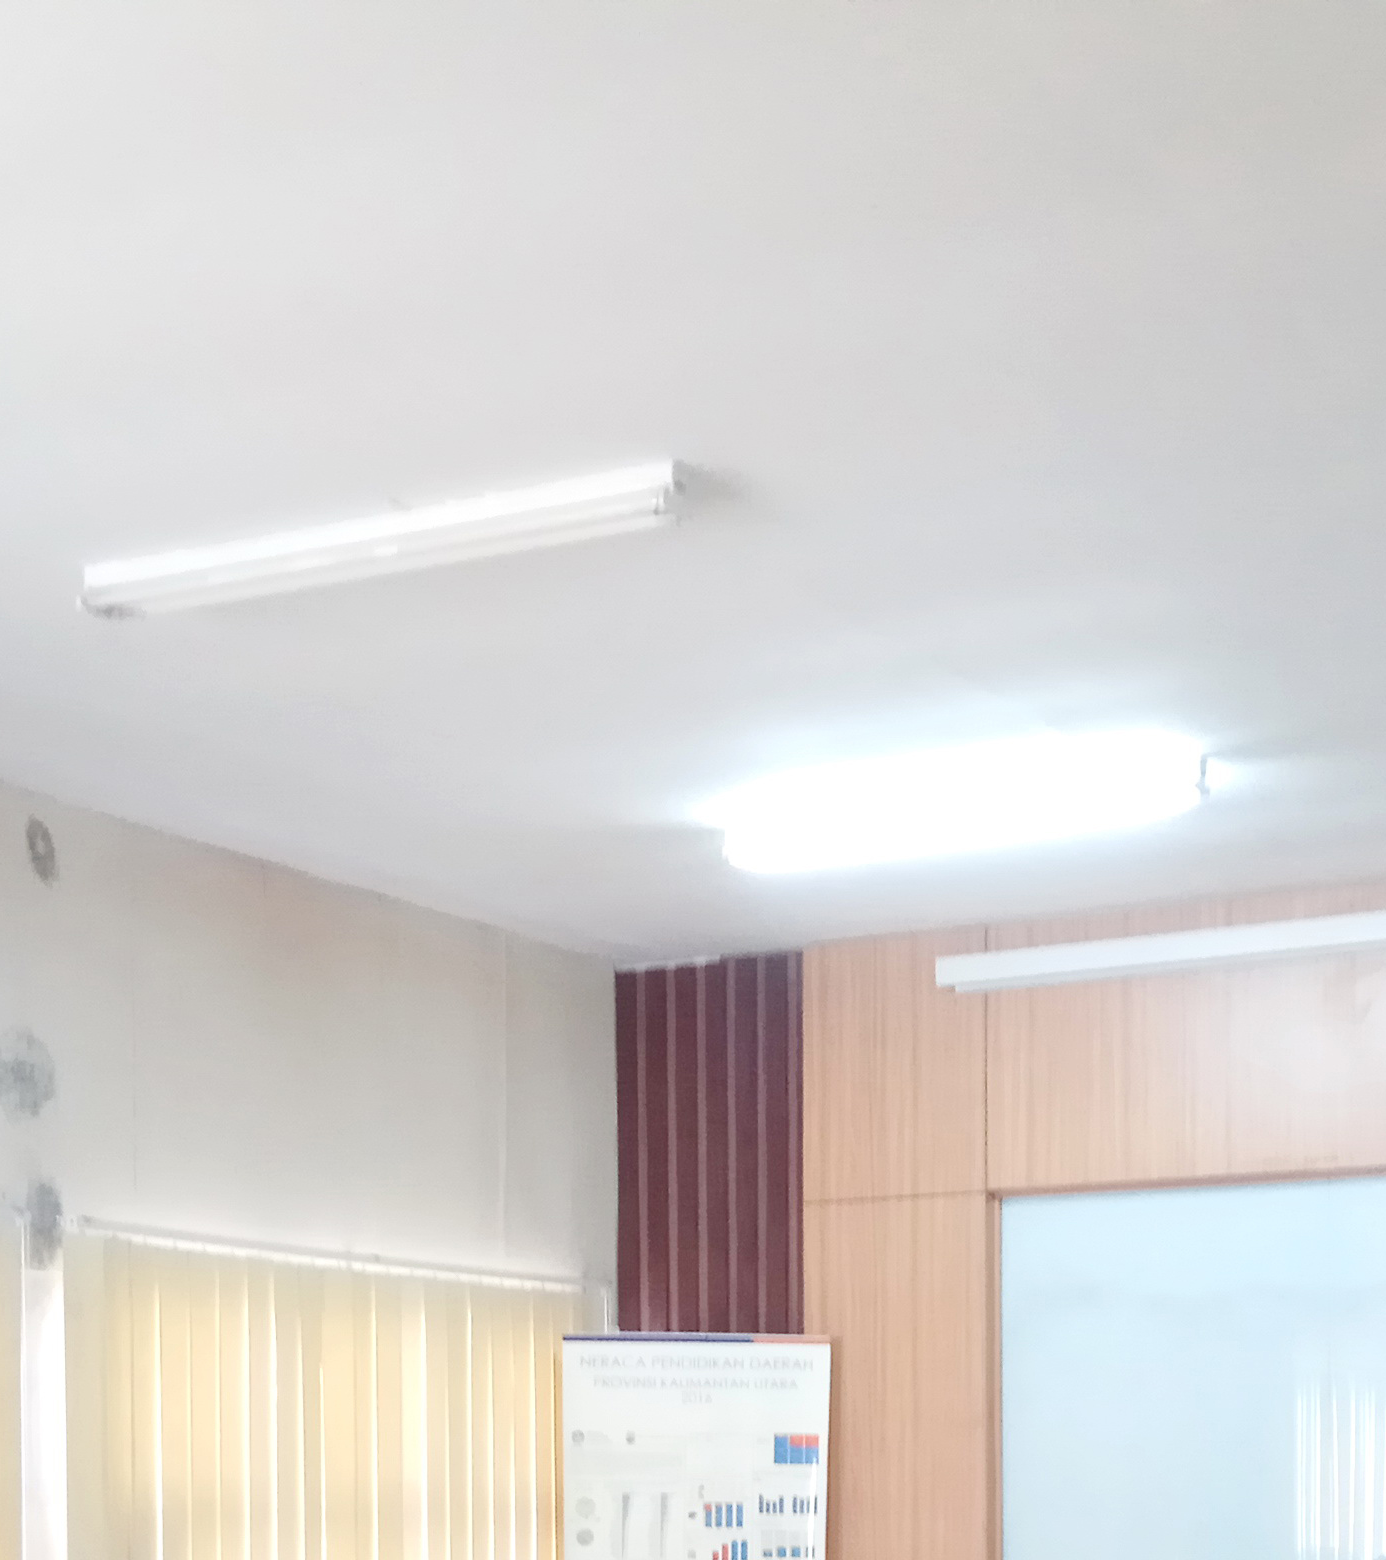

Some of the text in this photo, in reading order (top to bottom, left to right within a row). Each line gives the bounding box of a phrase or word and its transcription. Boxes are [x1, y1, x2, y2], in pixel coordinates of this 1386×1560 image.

[579, 1356, 814, 1372] NERACA PENDIDIKAN DAERAH
[593, 1377, 798, 1390] PROVINSI KALIMANTAN UTARA
